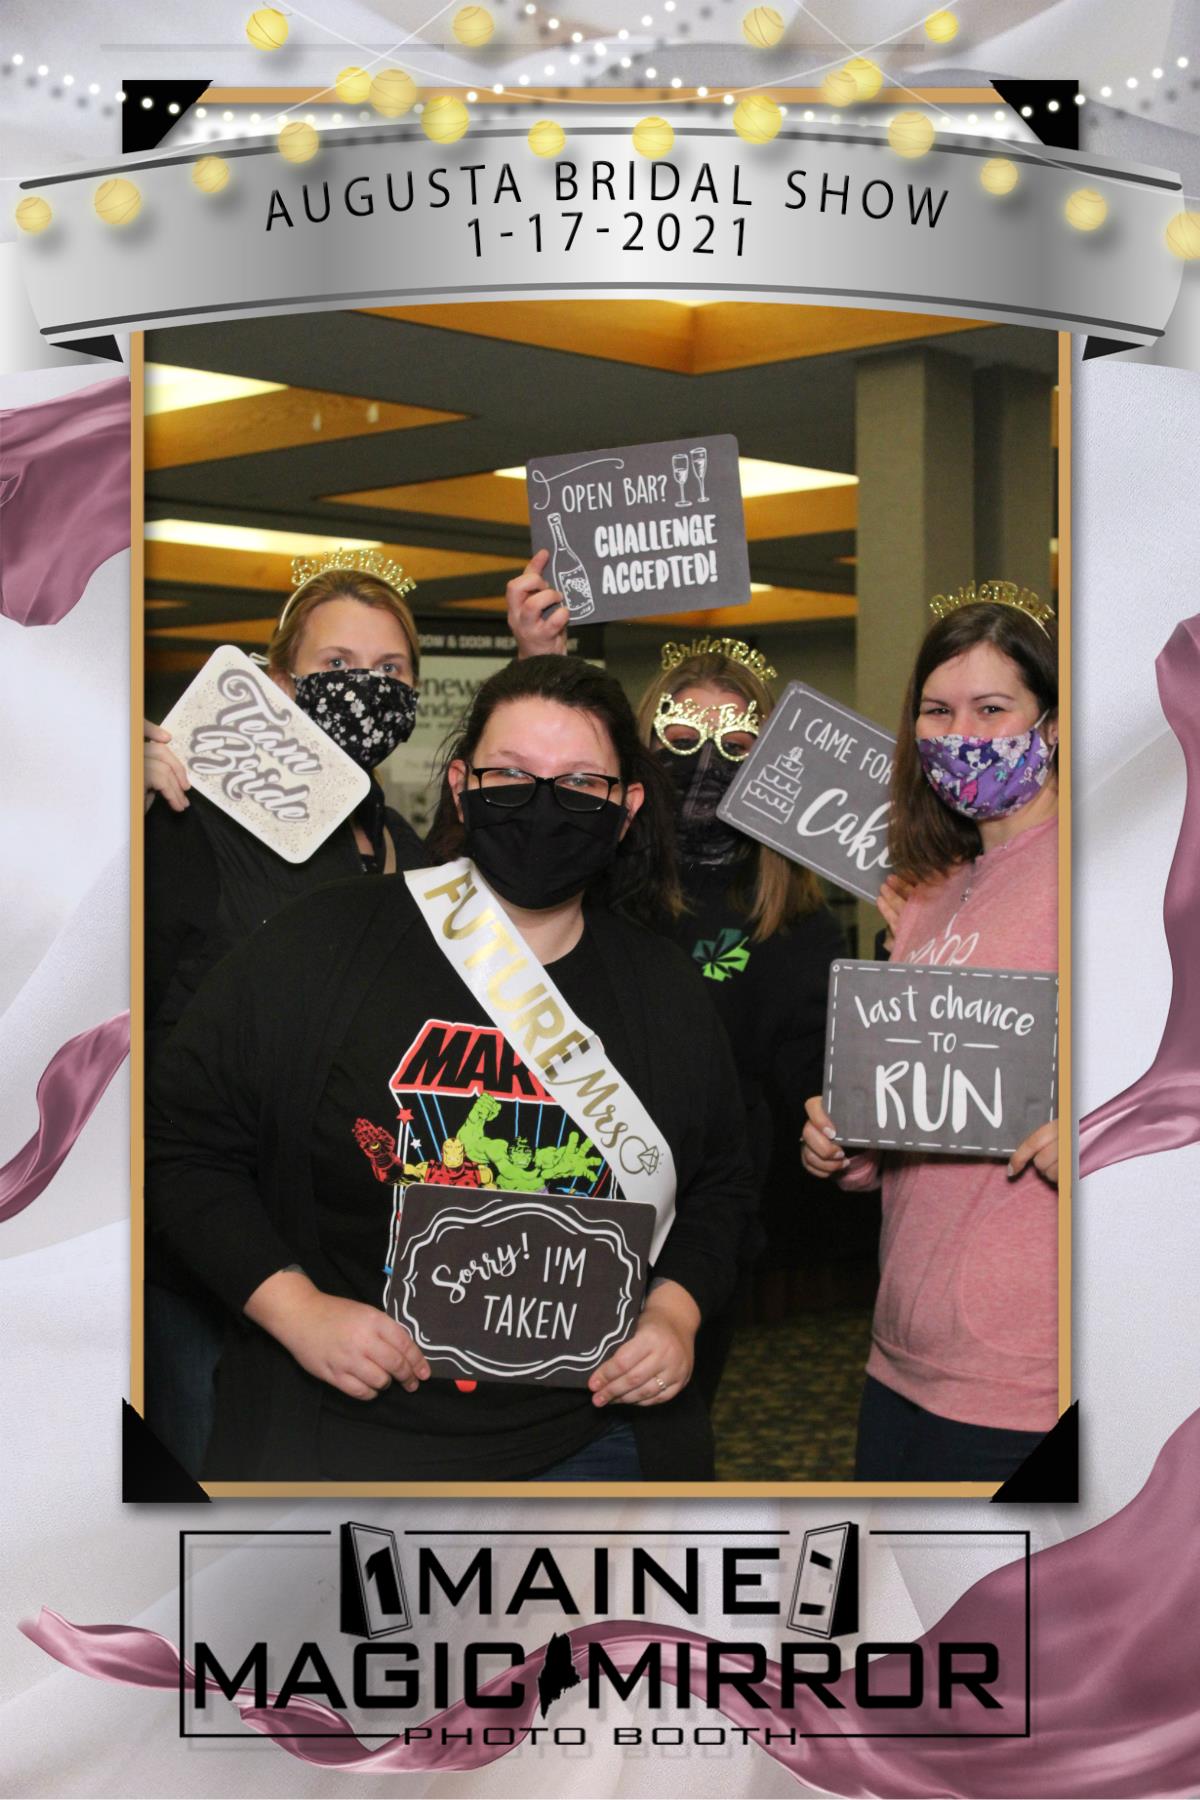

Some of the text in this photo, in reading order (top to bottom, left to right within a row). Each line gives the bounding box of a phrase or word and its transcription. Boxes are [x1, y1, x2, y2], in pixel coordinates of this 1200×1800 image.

[561, 475, 668, 513] OPEN BAR?
[594, 514, 718, 558] CHALLENGE
[602, 550, 719, 595] ACCEPTED!
[215, 668, 323, 776] Team
[788, 708, 801, 731] I
[805, 718, 858, 764] CAME
[188, 724, 310, 822] Bride
[423, 871, 629, 1149] FUTURE Mrs
[854, 985, 1035, 1036] last chance
[927, 1031, 957, 1053] TO
[875, 1060, 1003, 1134] RUN
[431, 1232, 587, 1304] Sorry! I'M
[483, 1294, 577, 1341] TAKEN
